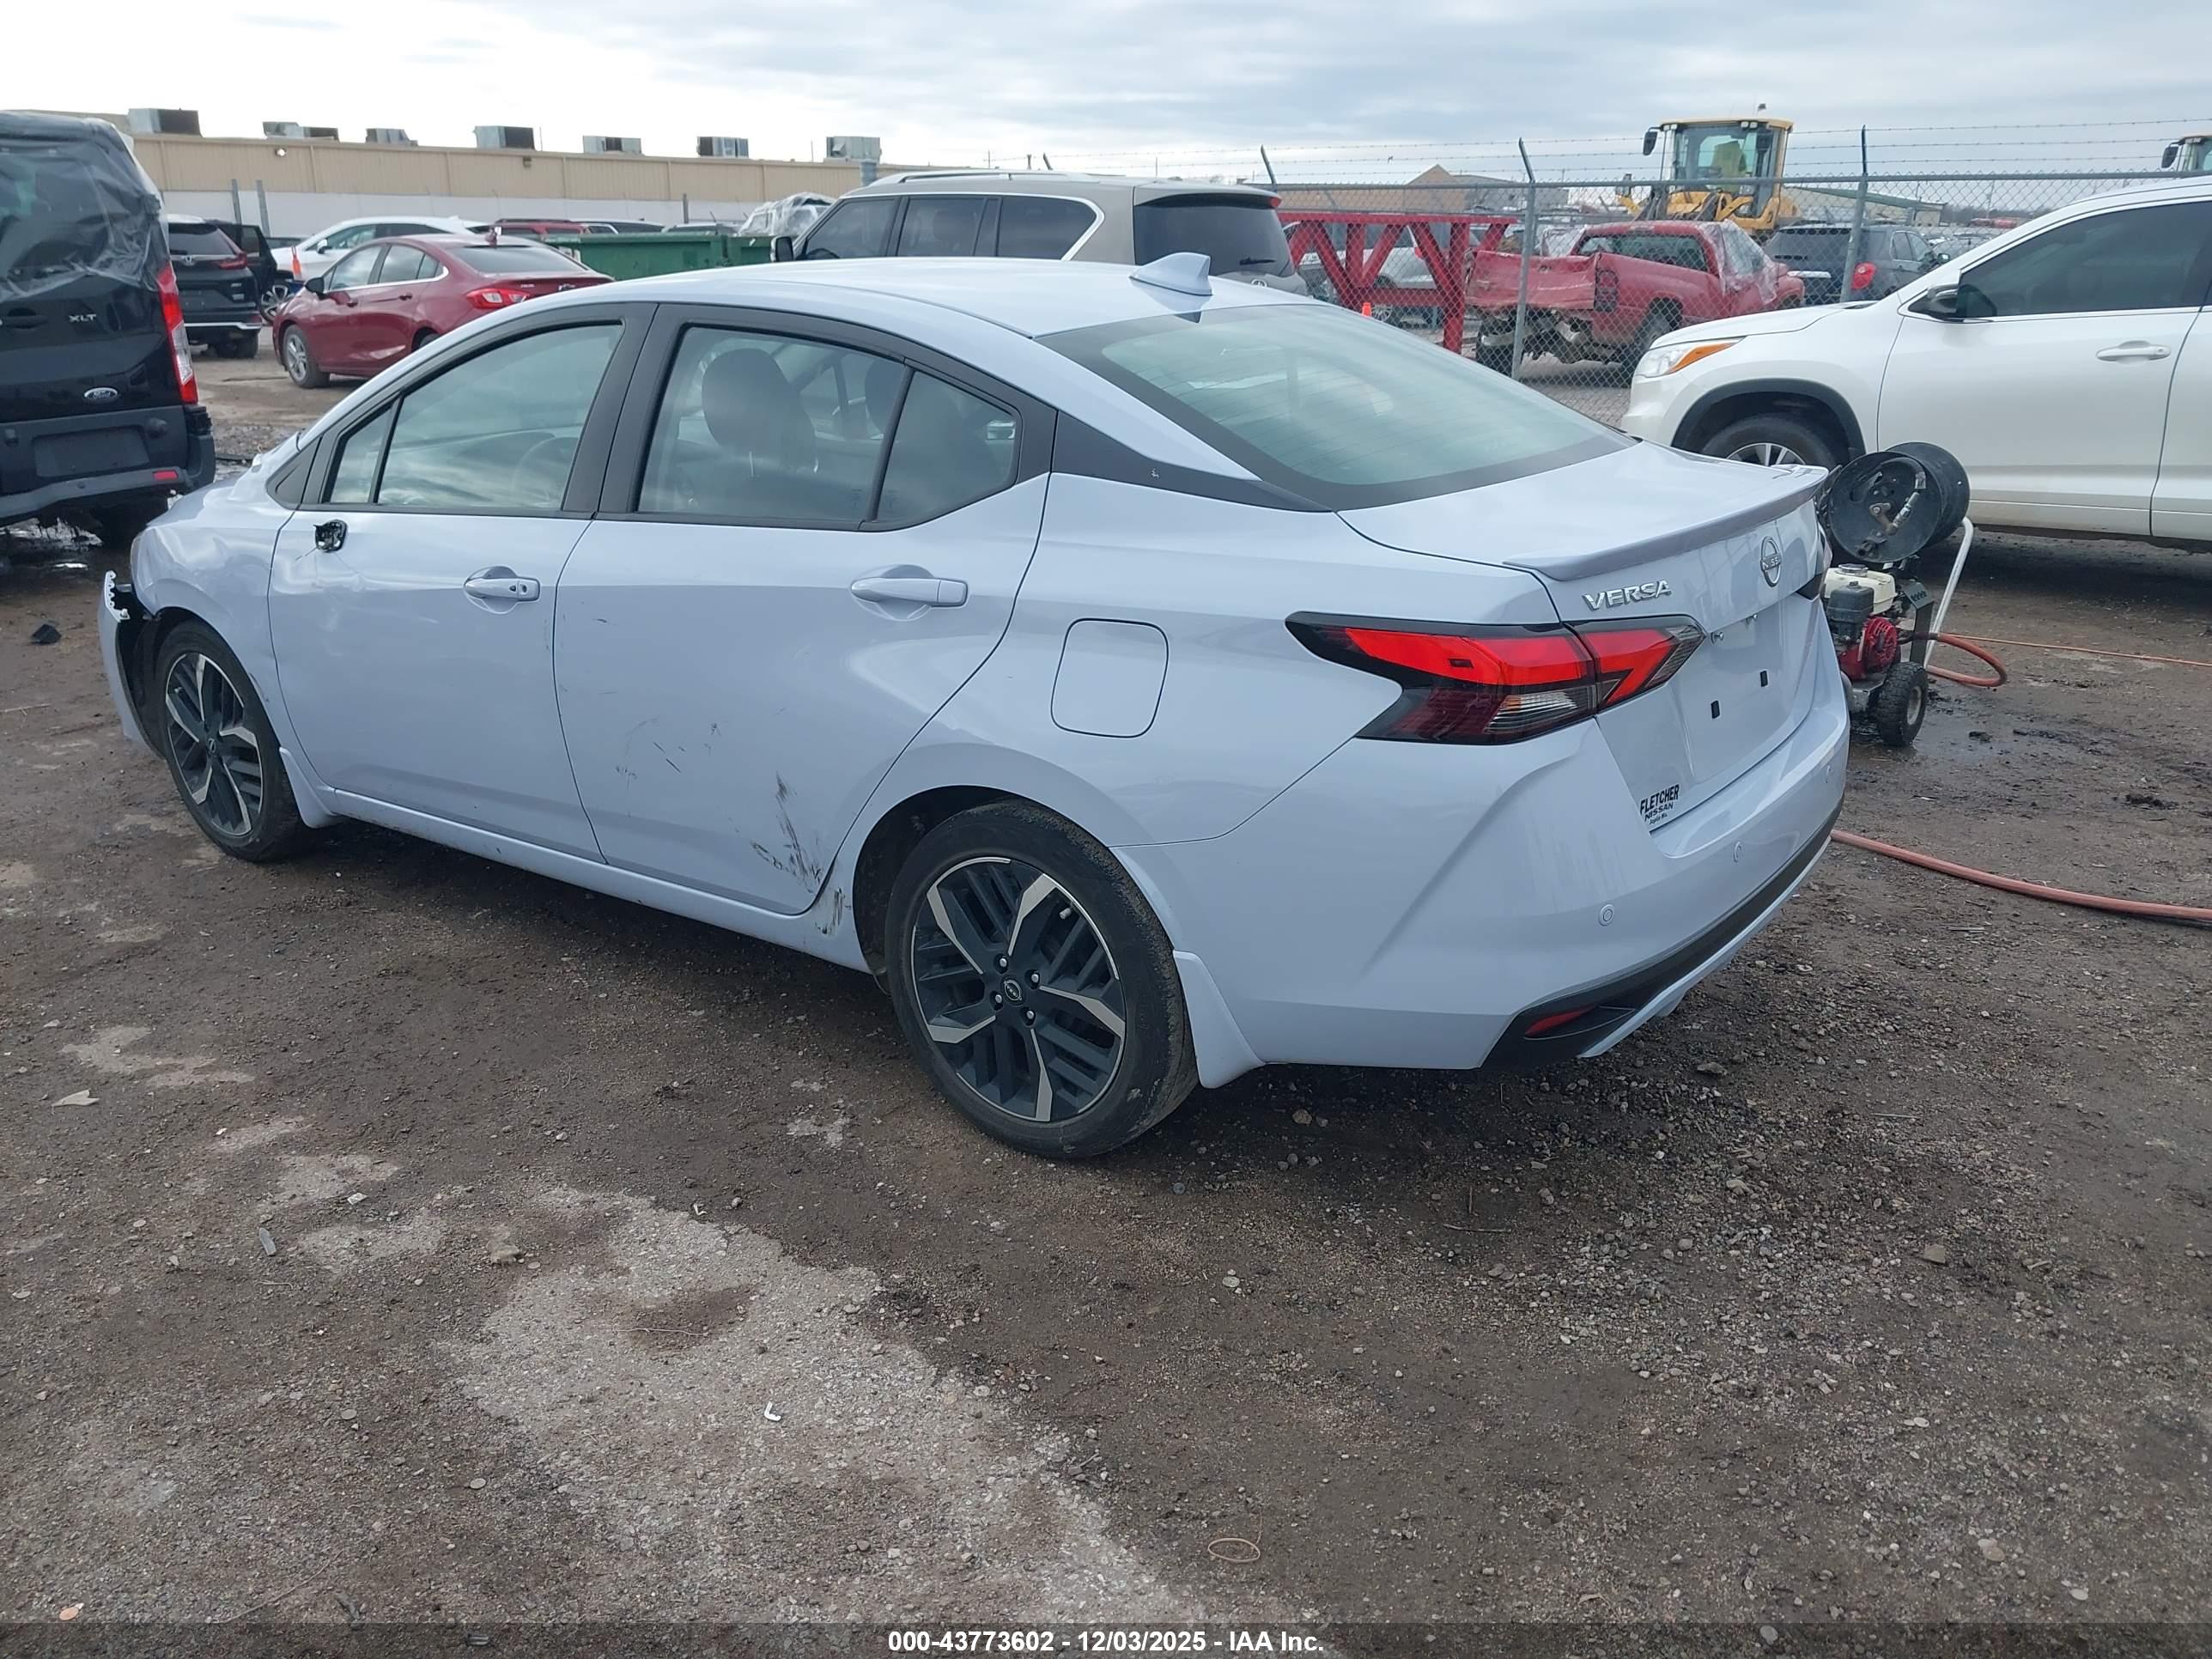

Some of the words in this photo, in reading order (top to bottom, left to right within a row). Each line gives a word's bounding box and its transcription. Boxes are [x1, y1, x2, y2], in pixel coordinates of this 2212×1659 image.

[69, 313, 96, 323] XLT
[1582, 580, 1672, 611] VERSA
[1640, 784, 1680, 816] FLETCHER
[1644, 802, 1674, 822] NISSAN
